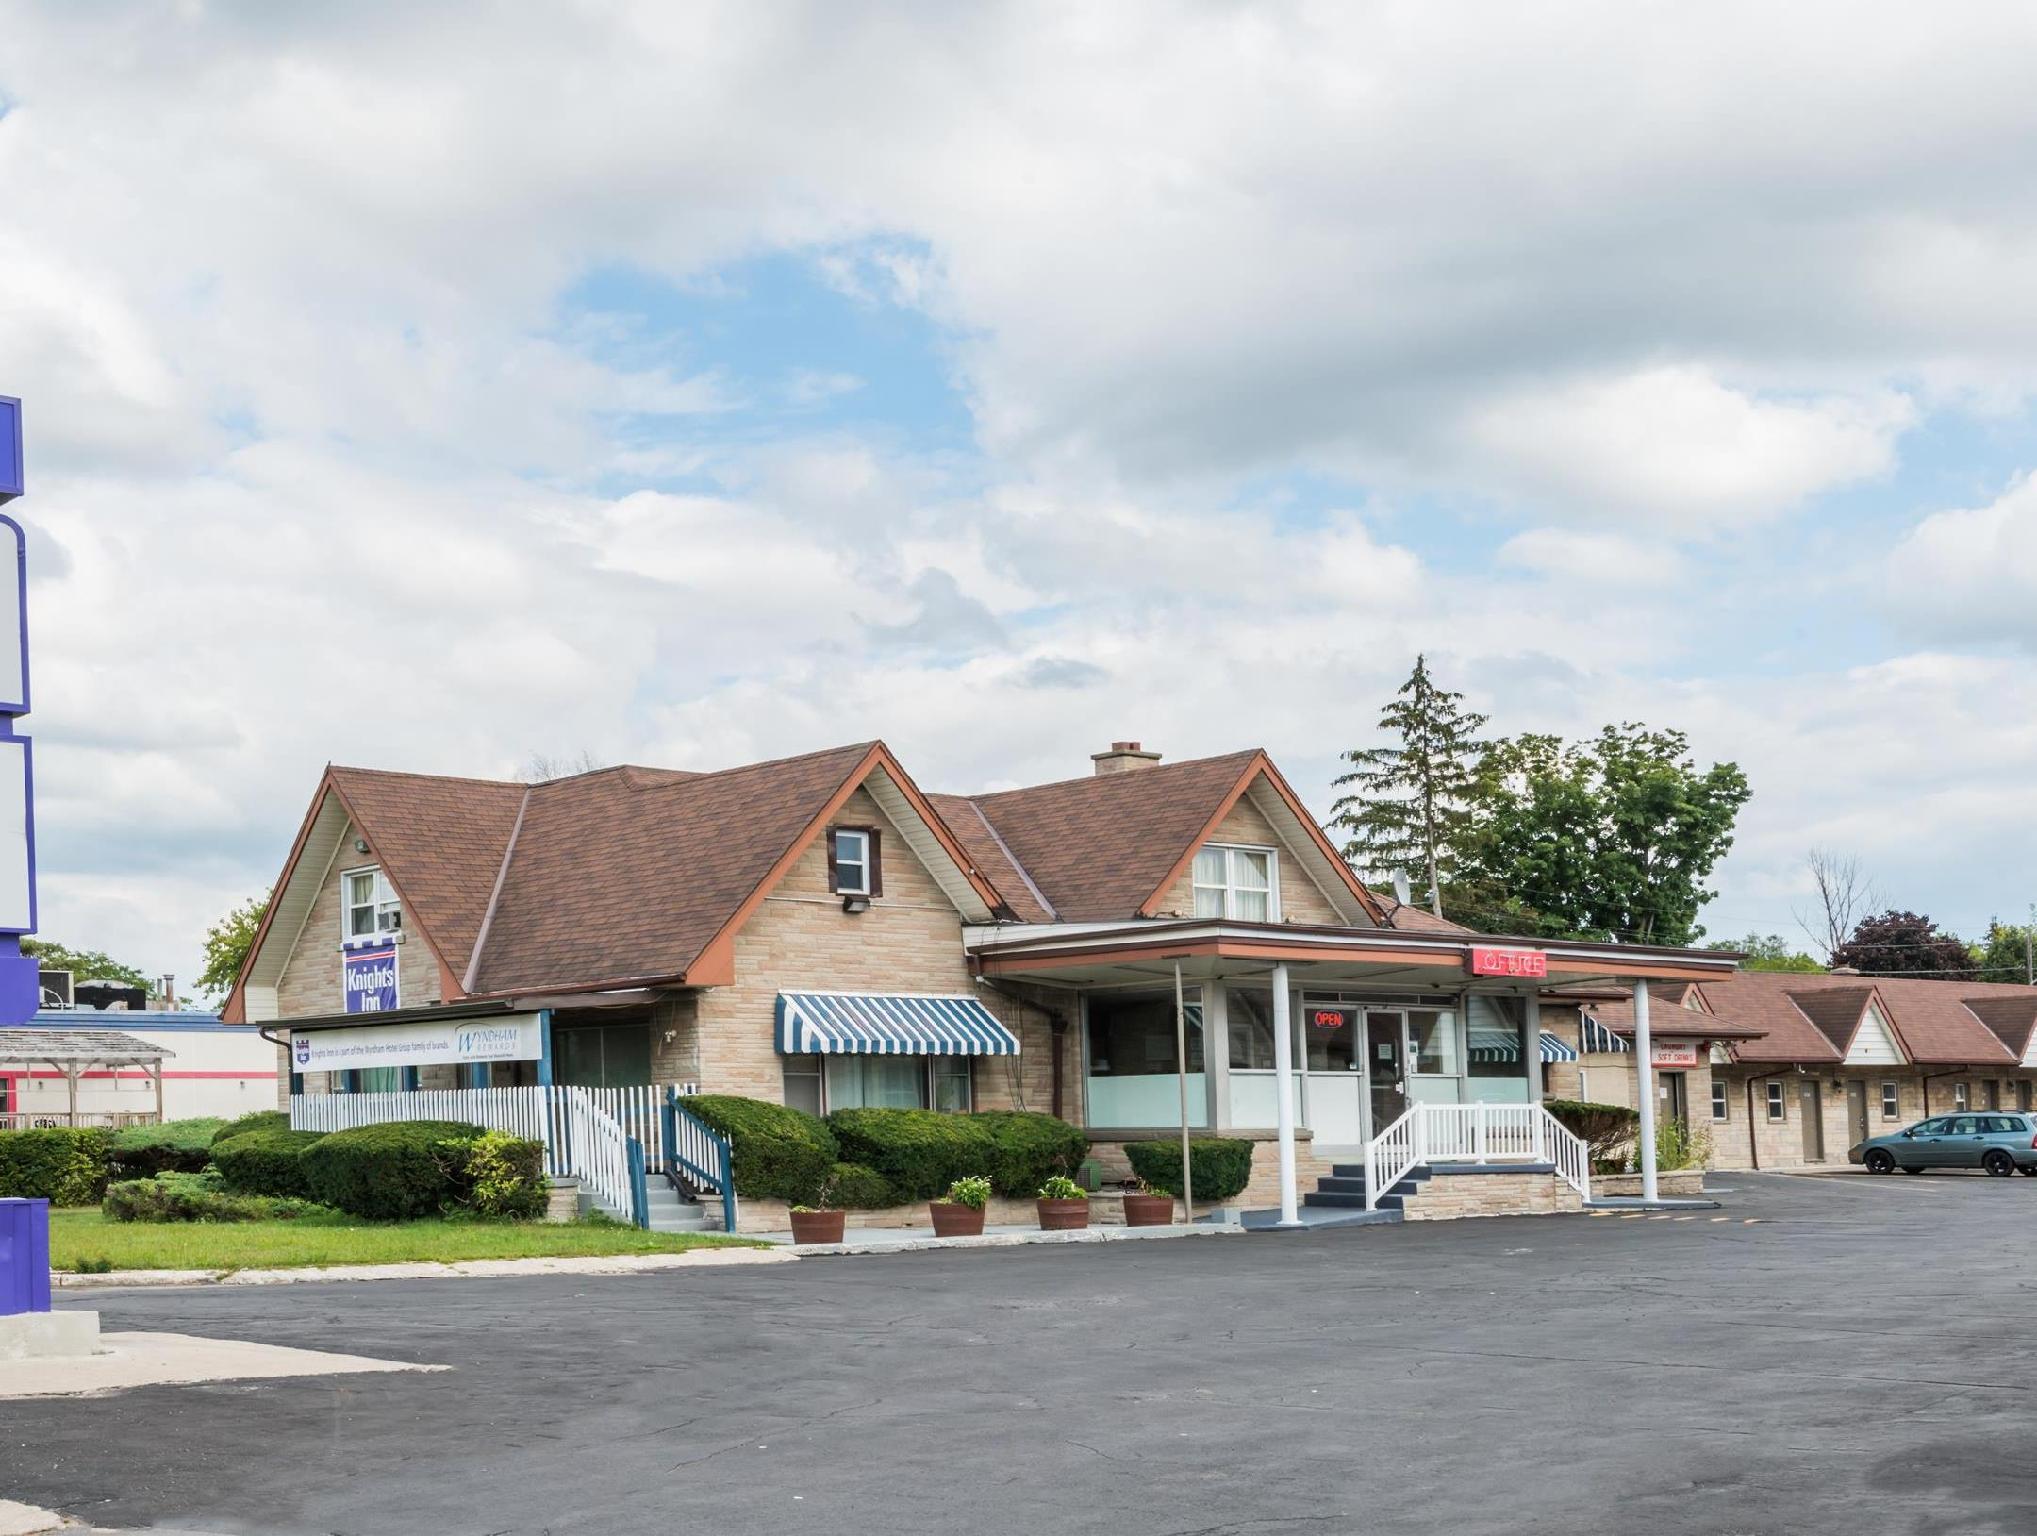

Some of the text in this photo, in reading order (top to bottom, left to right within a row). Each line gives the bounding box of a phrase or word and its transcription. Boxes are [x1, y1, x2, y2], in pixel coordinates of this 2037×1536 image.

[1484, 954, 1544, 972] OFFICE
[348, 965, 393, 994] Knights
[361, 992, 380, 1011] Inn
[1317, 1011, 1341, 1025] OPEN
[458, 1029, 517, 1053] WYNDHAM
